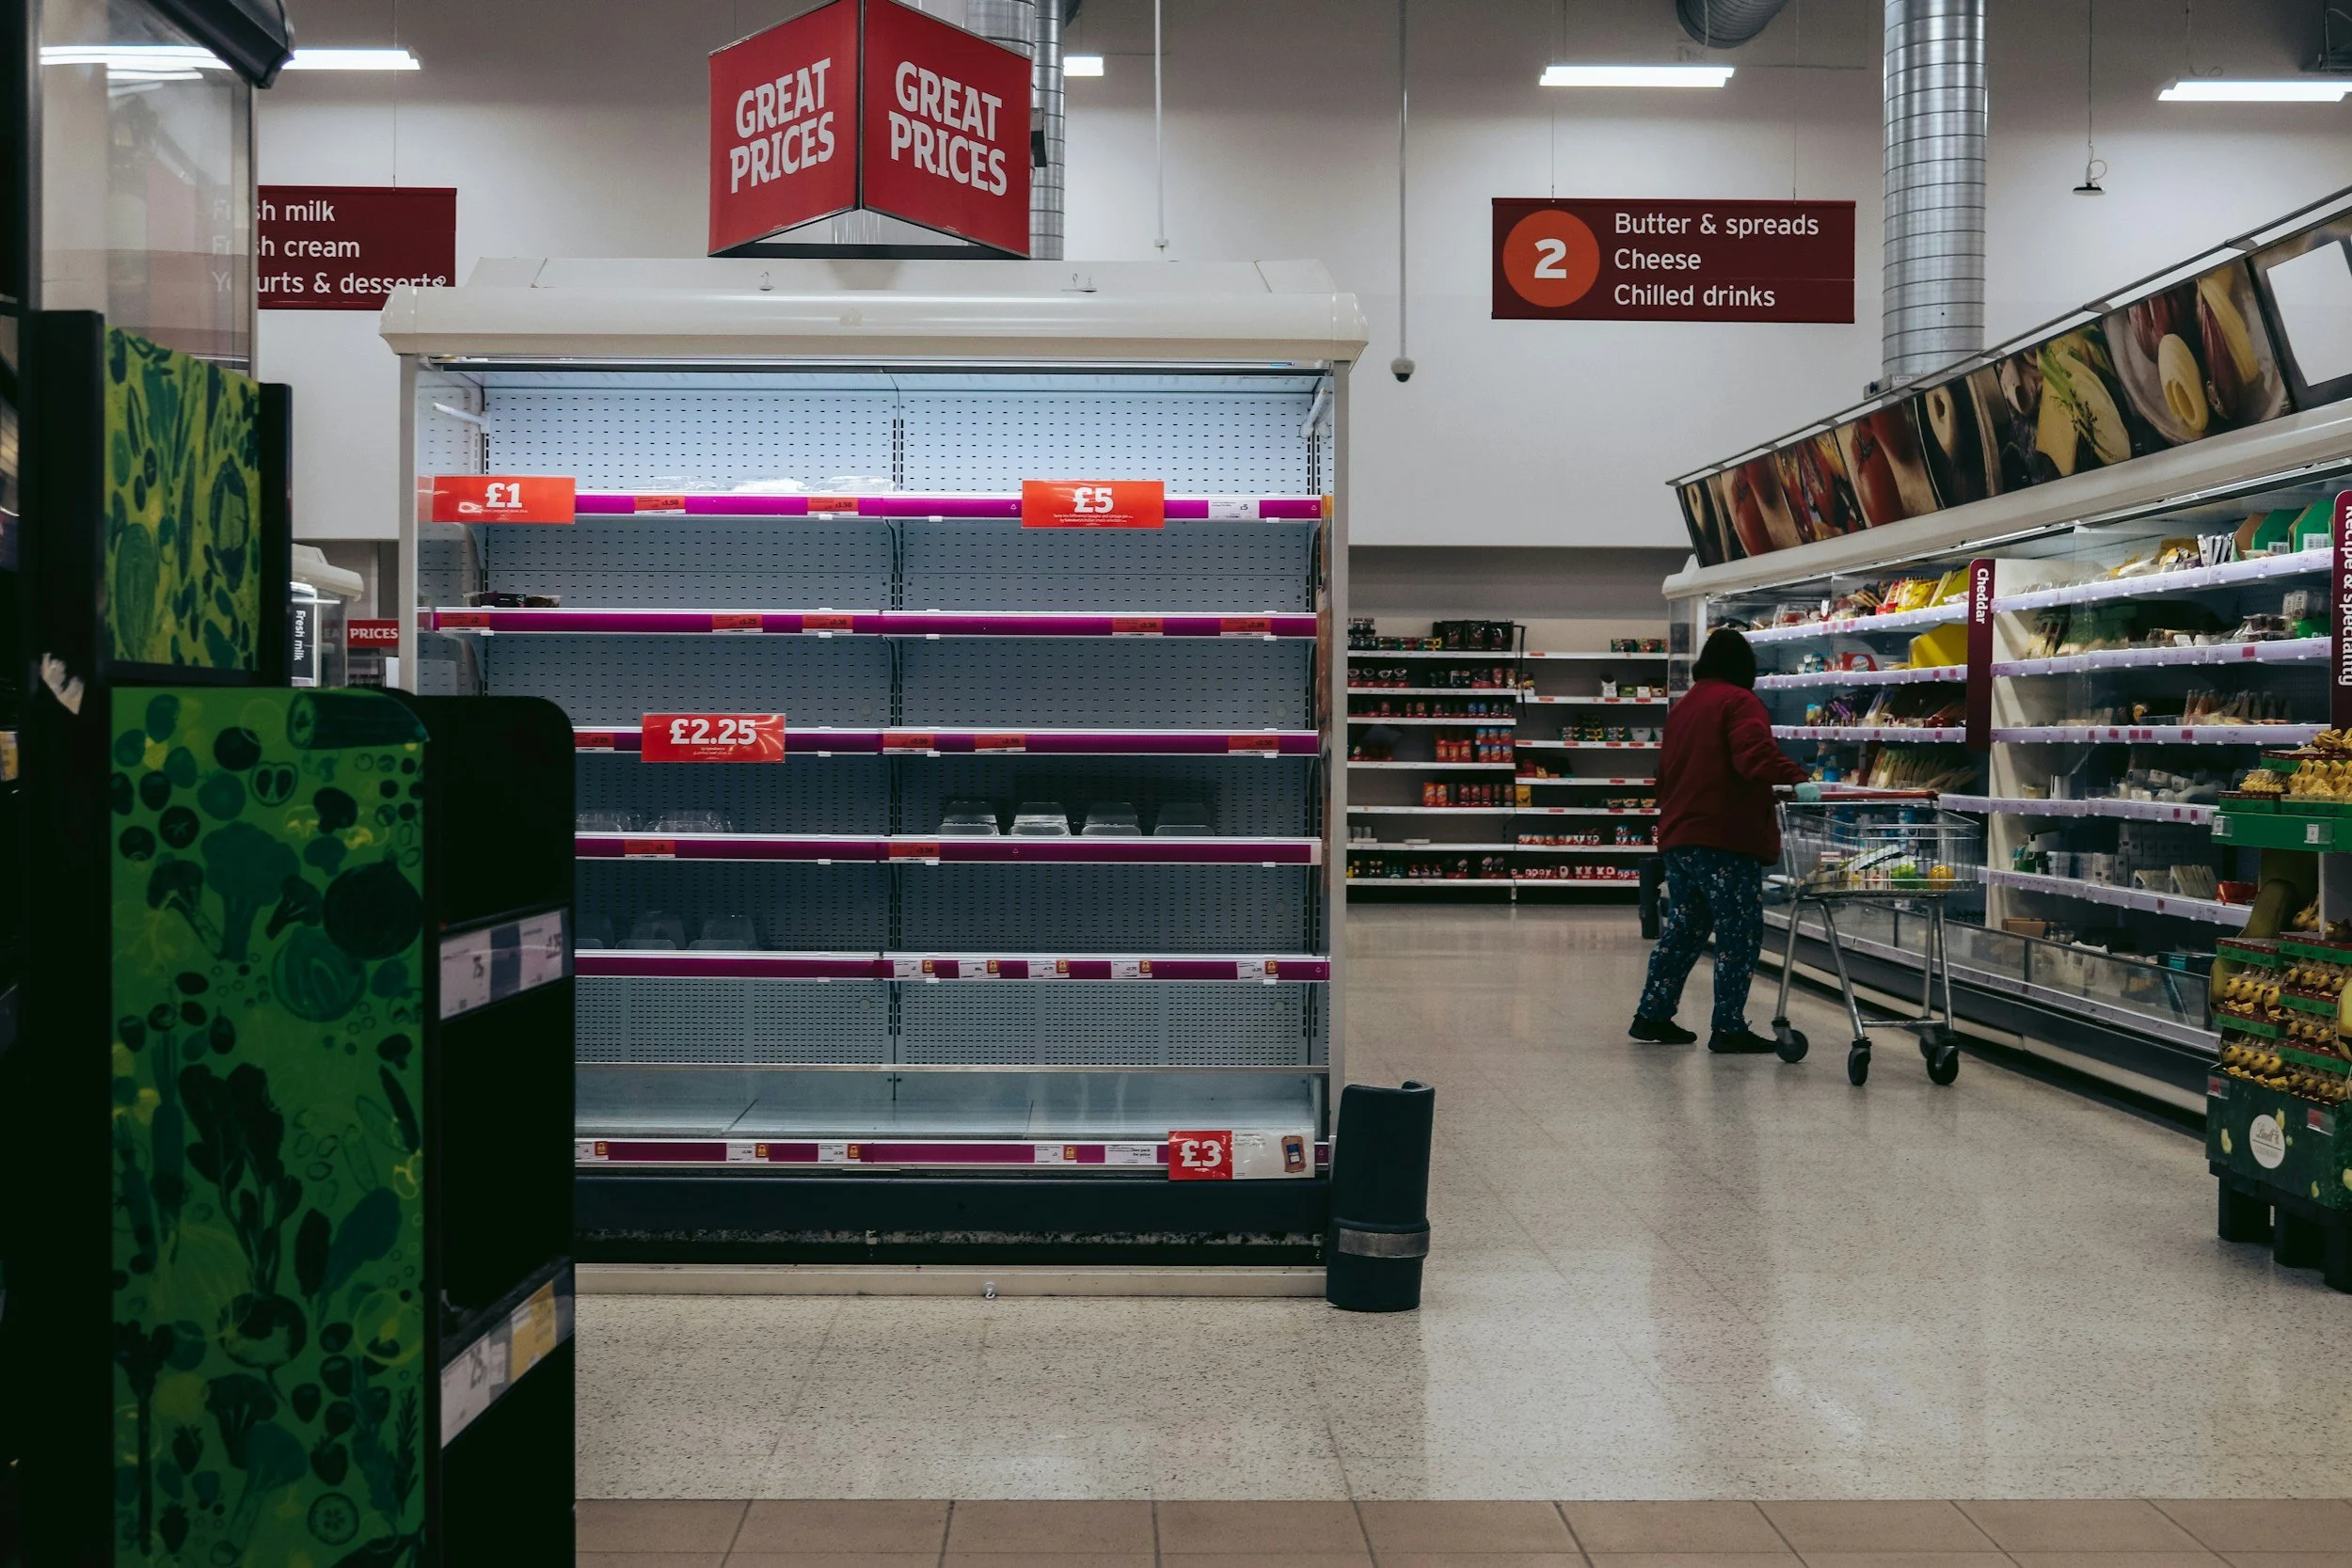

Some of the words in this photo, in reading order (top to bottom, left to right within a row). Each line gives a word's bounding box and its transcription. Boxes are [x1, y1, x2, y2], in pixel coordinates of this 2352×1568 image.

[735, 57, 831, 139] GREAT
[895, 60, 1003, 142] GREAT
[729, 111, 835, 194] PRICES
[888, 110, 1008, 197] PRICES
[213, 198, 276, 221] Frh
[285, 200, 336, 222] milk
[1614, 213, 1692, 234] Butter
[1699, 214, 1717, 235] &
[1725, 214, 1820, 239] spreads
[212, 235, 275, 257] Frh
[284, 240, 360, 258] cream
[1534, 238, 1567, 279] 2
[1613, 247, 1702, 270] Cheese
[211, 271, 304, 293] Yurts
[313, 272, 331, 293] &
[1613, 284, 1693, 306] Chilled
[1703, 285, 1776, 307] drinks
[485, 482, 523, 508] £1
[1073, 486, 1114, 514] £5
[1976, 567, 1990, 624] Cheddar
[294, 610, 306, 638] Fresh
[349, 628, 399, 640] PRICES
[294, 640, 304, 661] milk
[669, 718, 757, 745] £2.25
[1180, 1140, 1223, 1167] £3
